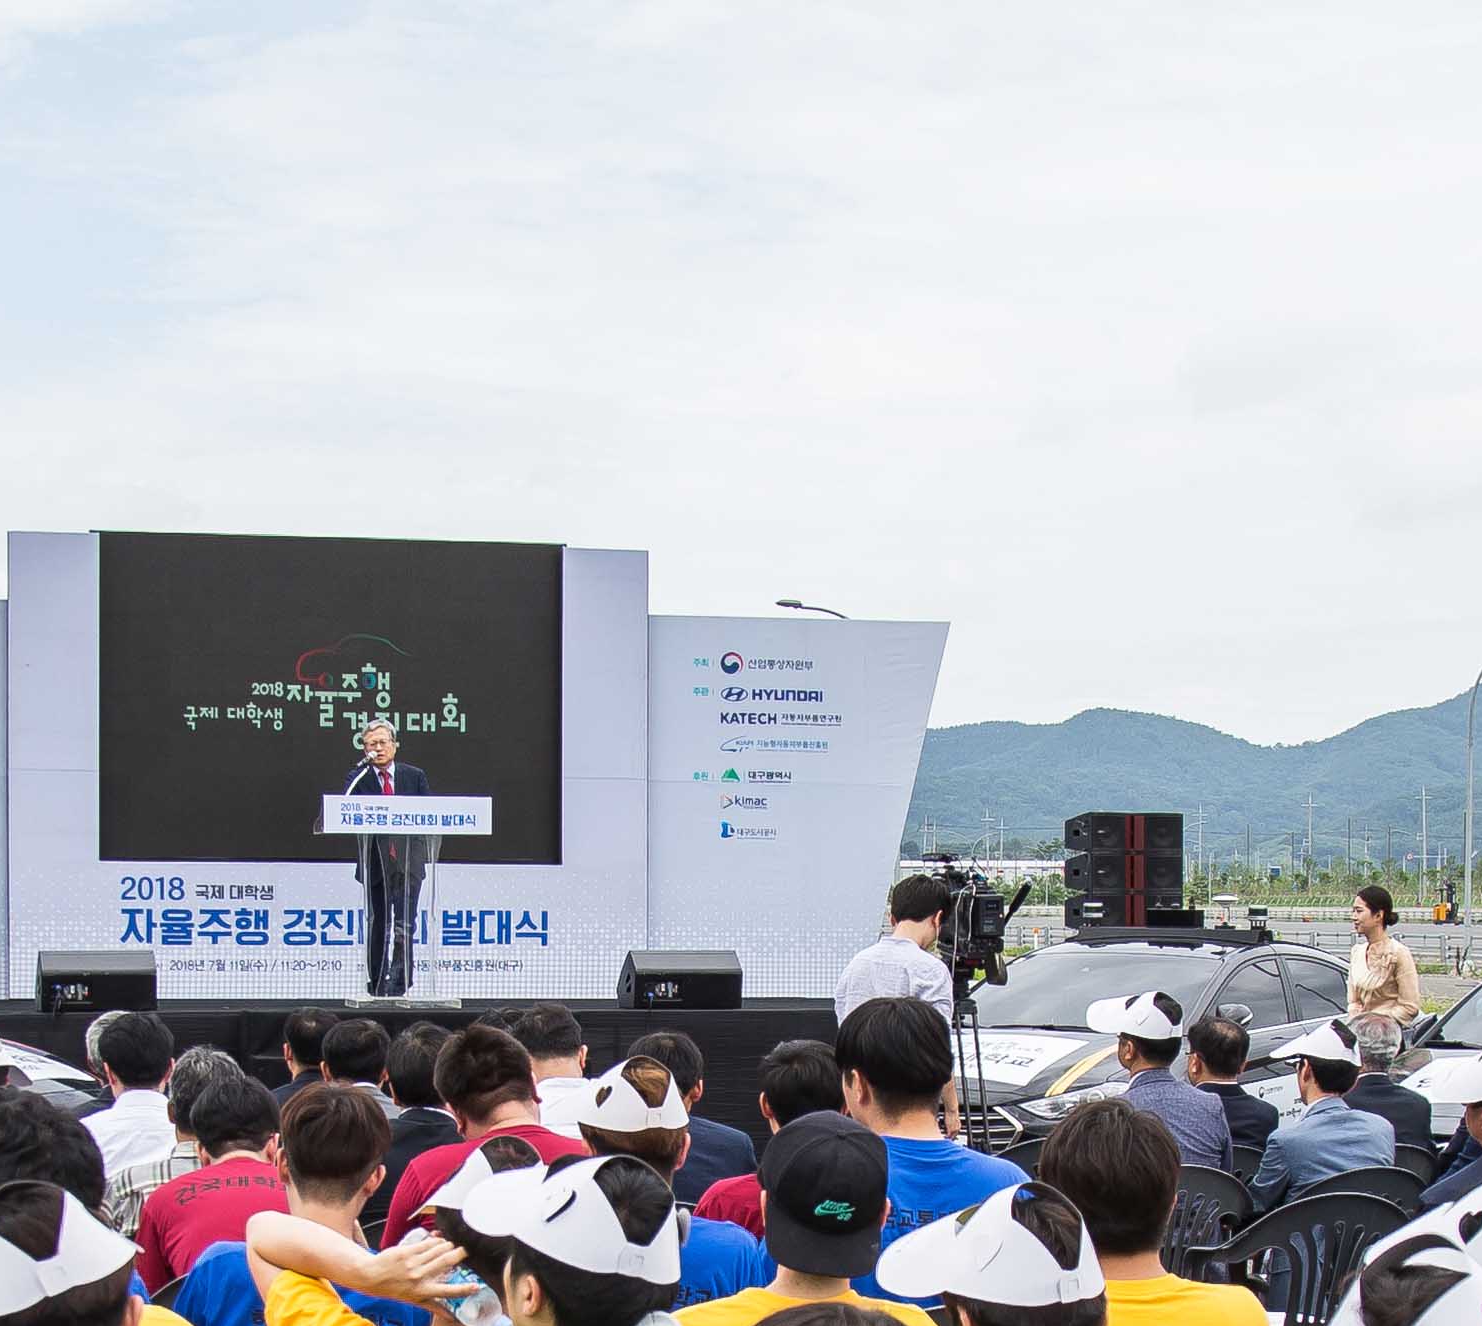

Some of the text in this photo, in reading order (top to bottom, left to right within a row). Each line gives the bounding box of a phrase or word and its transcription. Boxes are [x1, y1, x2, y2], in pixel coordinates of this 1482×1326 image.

[748, 658, 814, 672] 산업통상자원부
[252, 663, 390, 728] 2018 자율주행
[752, 689, 823, 703] HYUNDAI
[184, 706, 218, 731] 국제
[227, 702, 283, 731] 대학생
[720, 712, 777, 725] KATECH
[748, 770, 792, 780] 대구광역시
[340, 813, 476, 827] 자율주행 경진대회 발대식
[120, 876, 275, 901] 2018 국제 대학생
[120, 907, 270, 947] 자율주행
[442, 907, 549, 947] 발대식
[169, 959, 205, 972] 2018년
[209, 959, 226, 972] 7월
[230, 959, 268, 973] 11일(수)
[821, 1199, 850, 1211] NIKE
